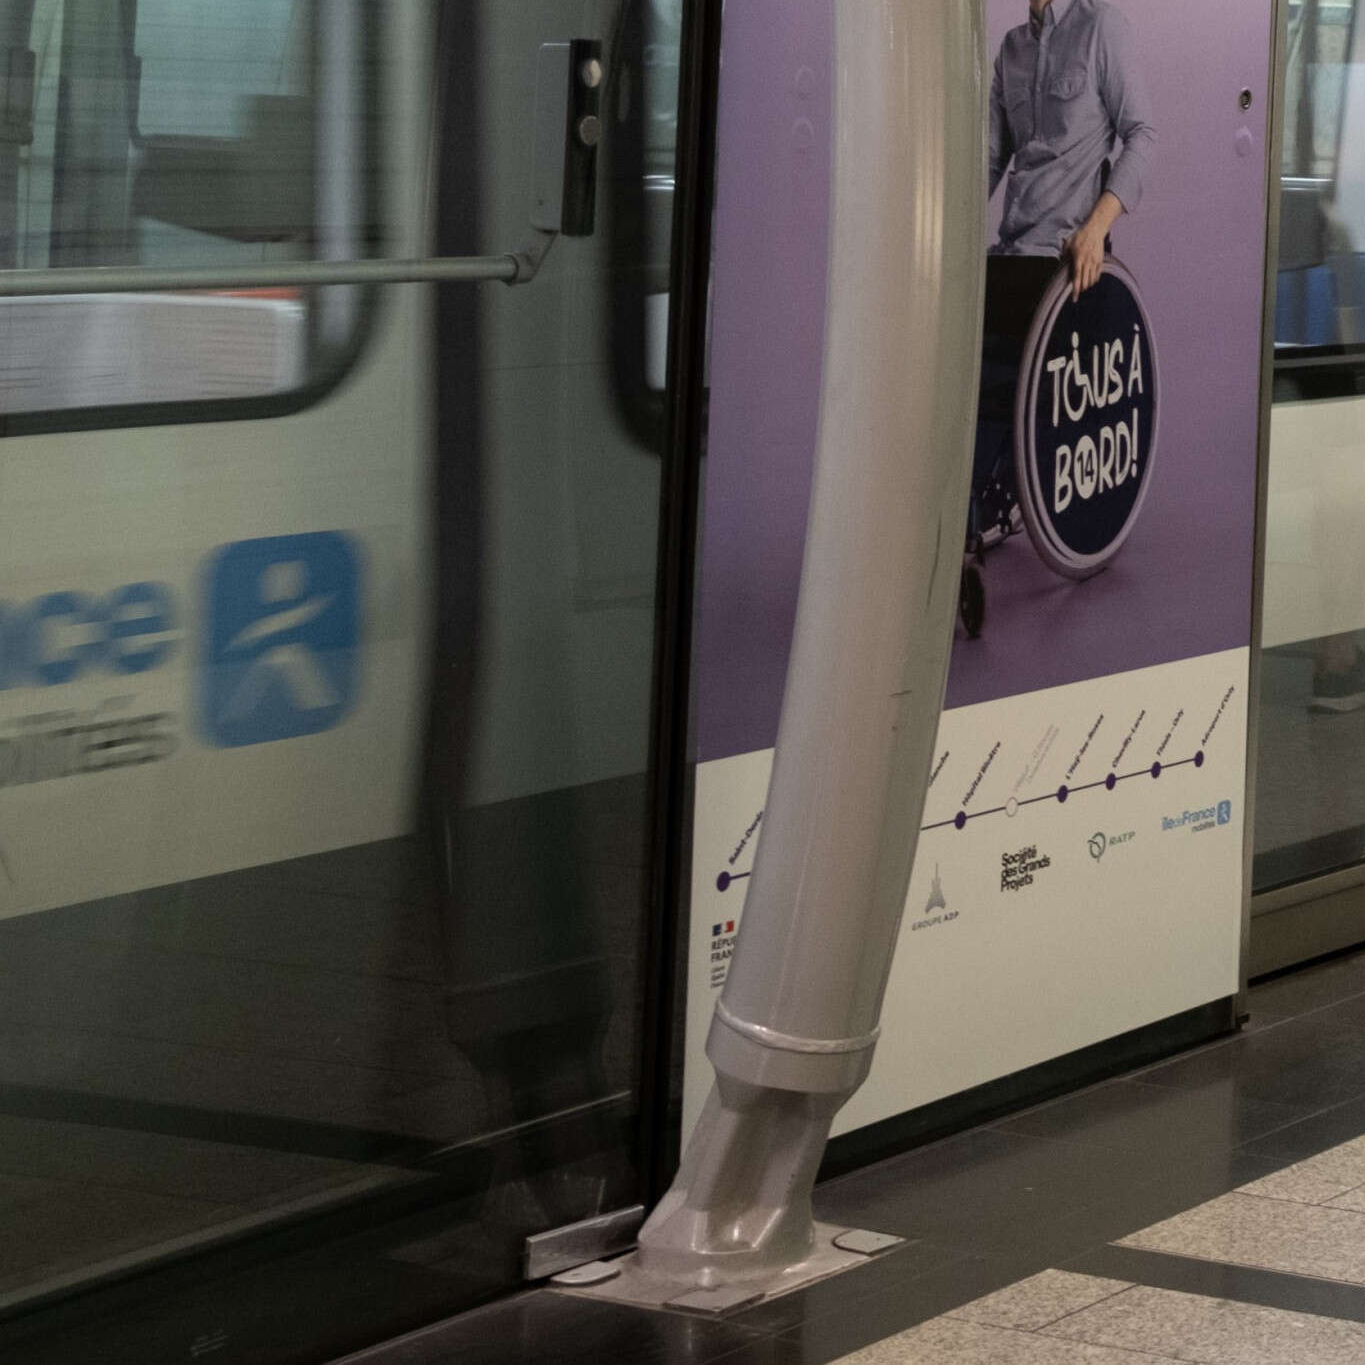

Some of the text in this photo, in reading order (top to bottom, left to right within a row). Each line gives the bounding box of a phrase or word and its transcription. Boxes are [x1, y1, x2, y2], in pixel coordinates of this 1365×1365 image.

[1108, 830, 1137, 847] RATP
[1001, 844, 1037, 867] Société
[1001, 854, 1051, 881] des Grands
[1001, 873, 1034, 893] Projets
